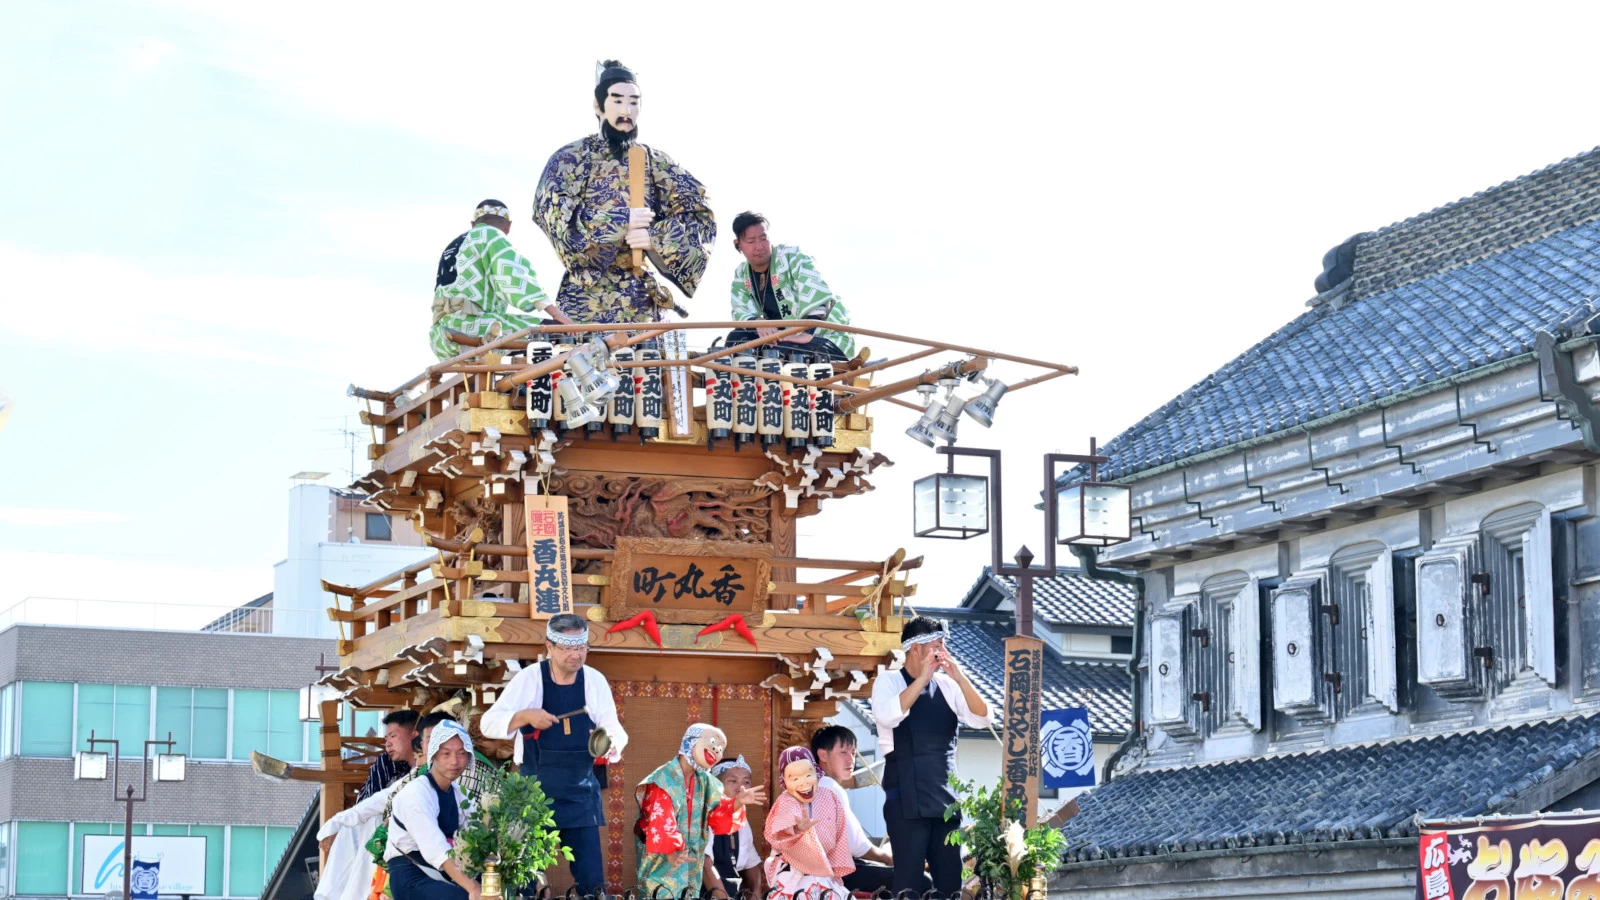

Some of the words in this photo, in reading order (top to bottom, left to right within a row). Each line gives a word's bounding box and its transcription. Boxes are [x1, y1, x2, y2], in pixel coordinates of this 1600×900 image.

[641, 352, 661, 419] 香丸町
[737, 361, 757, 426] 香丸町
[762, 363, 783, 428] 香丸町
[533, 538, 561, 613] 香丸連
[633, 562, 745, 607] 香丸町
[1424, 837, 1451, 900] 広島
